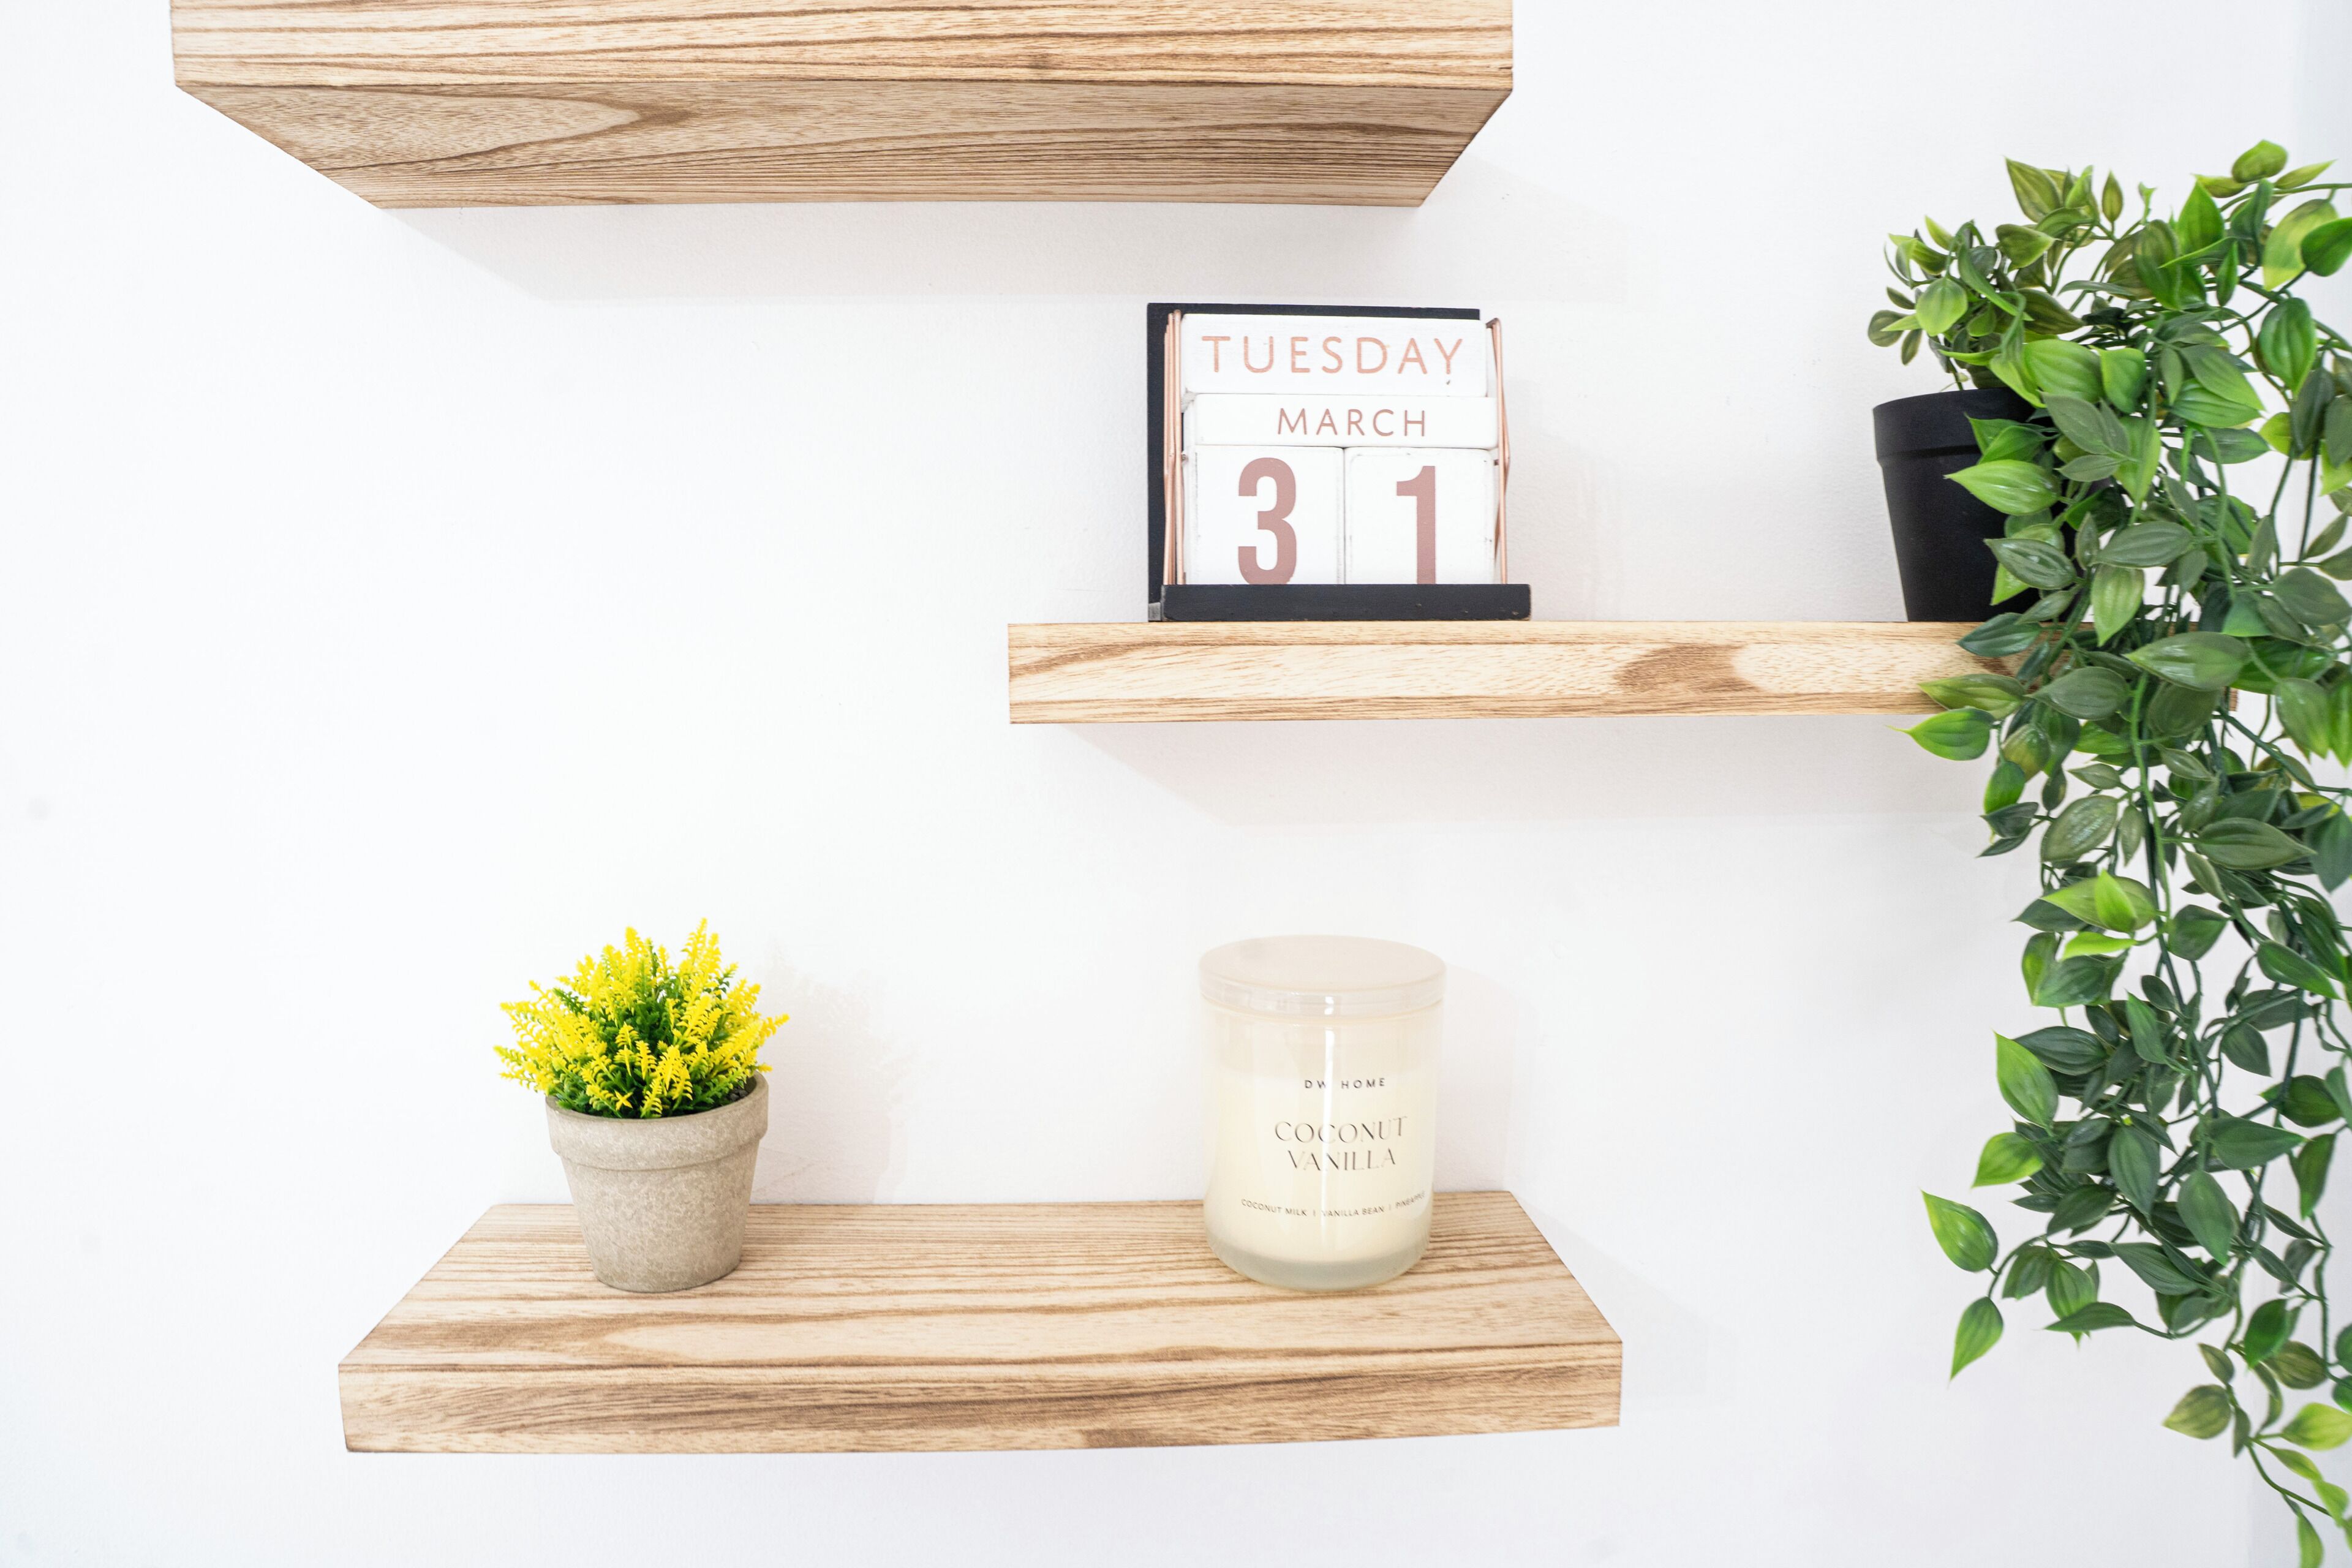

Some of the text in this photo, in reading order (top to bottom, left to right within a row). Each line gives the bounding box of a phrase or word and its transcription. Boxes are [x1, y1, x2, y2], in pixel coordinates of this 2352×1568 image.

[1201, 336, 1463, 374] TUESDAY
[1277, 408, 1425, 437] MARCH
[1238, 457, 1436, 584] 3 1
[1304, 1077, 1385, 1089] DW HOME
[1275, 1115, 1408, 1144] COCONUT
[1287, 1147, 1396, 1171] VANILLA
[1241, 1199, 1283, 1213] COCONUT
[1285, 1207, 1308, 1216] MILK
[1362, 1205, 1385, 1215] BEAN
